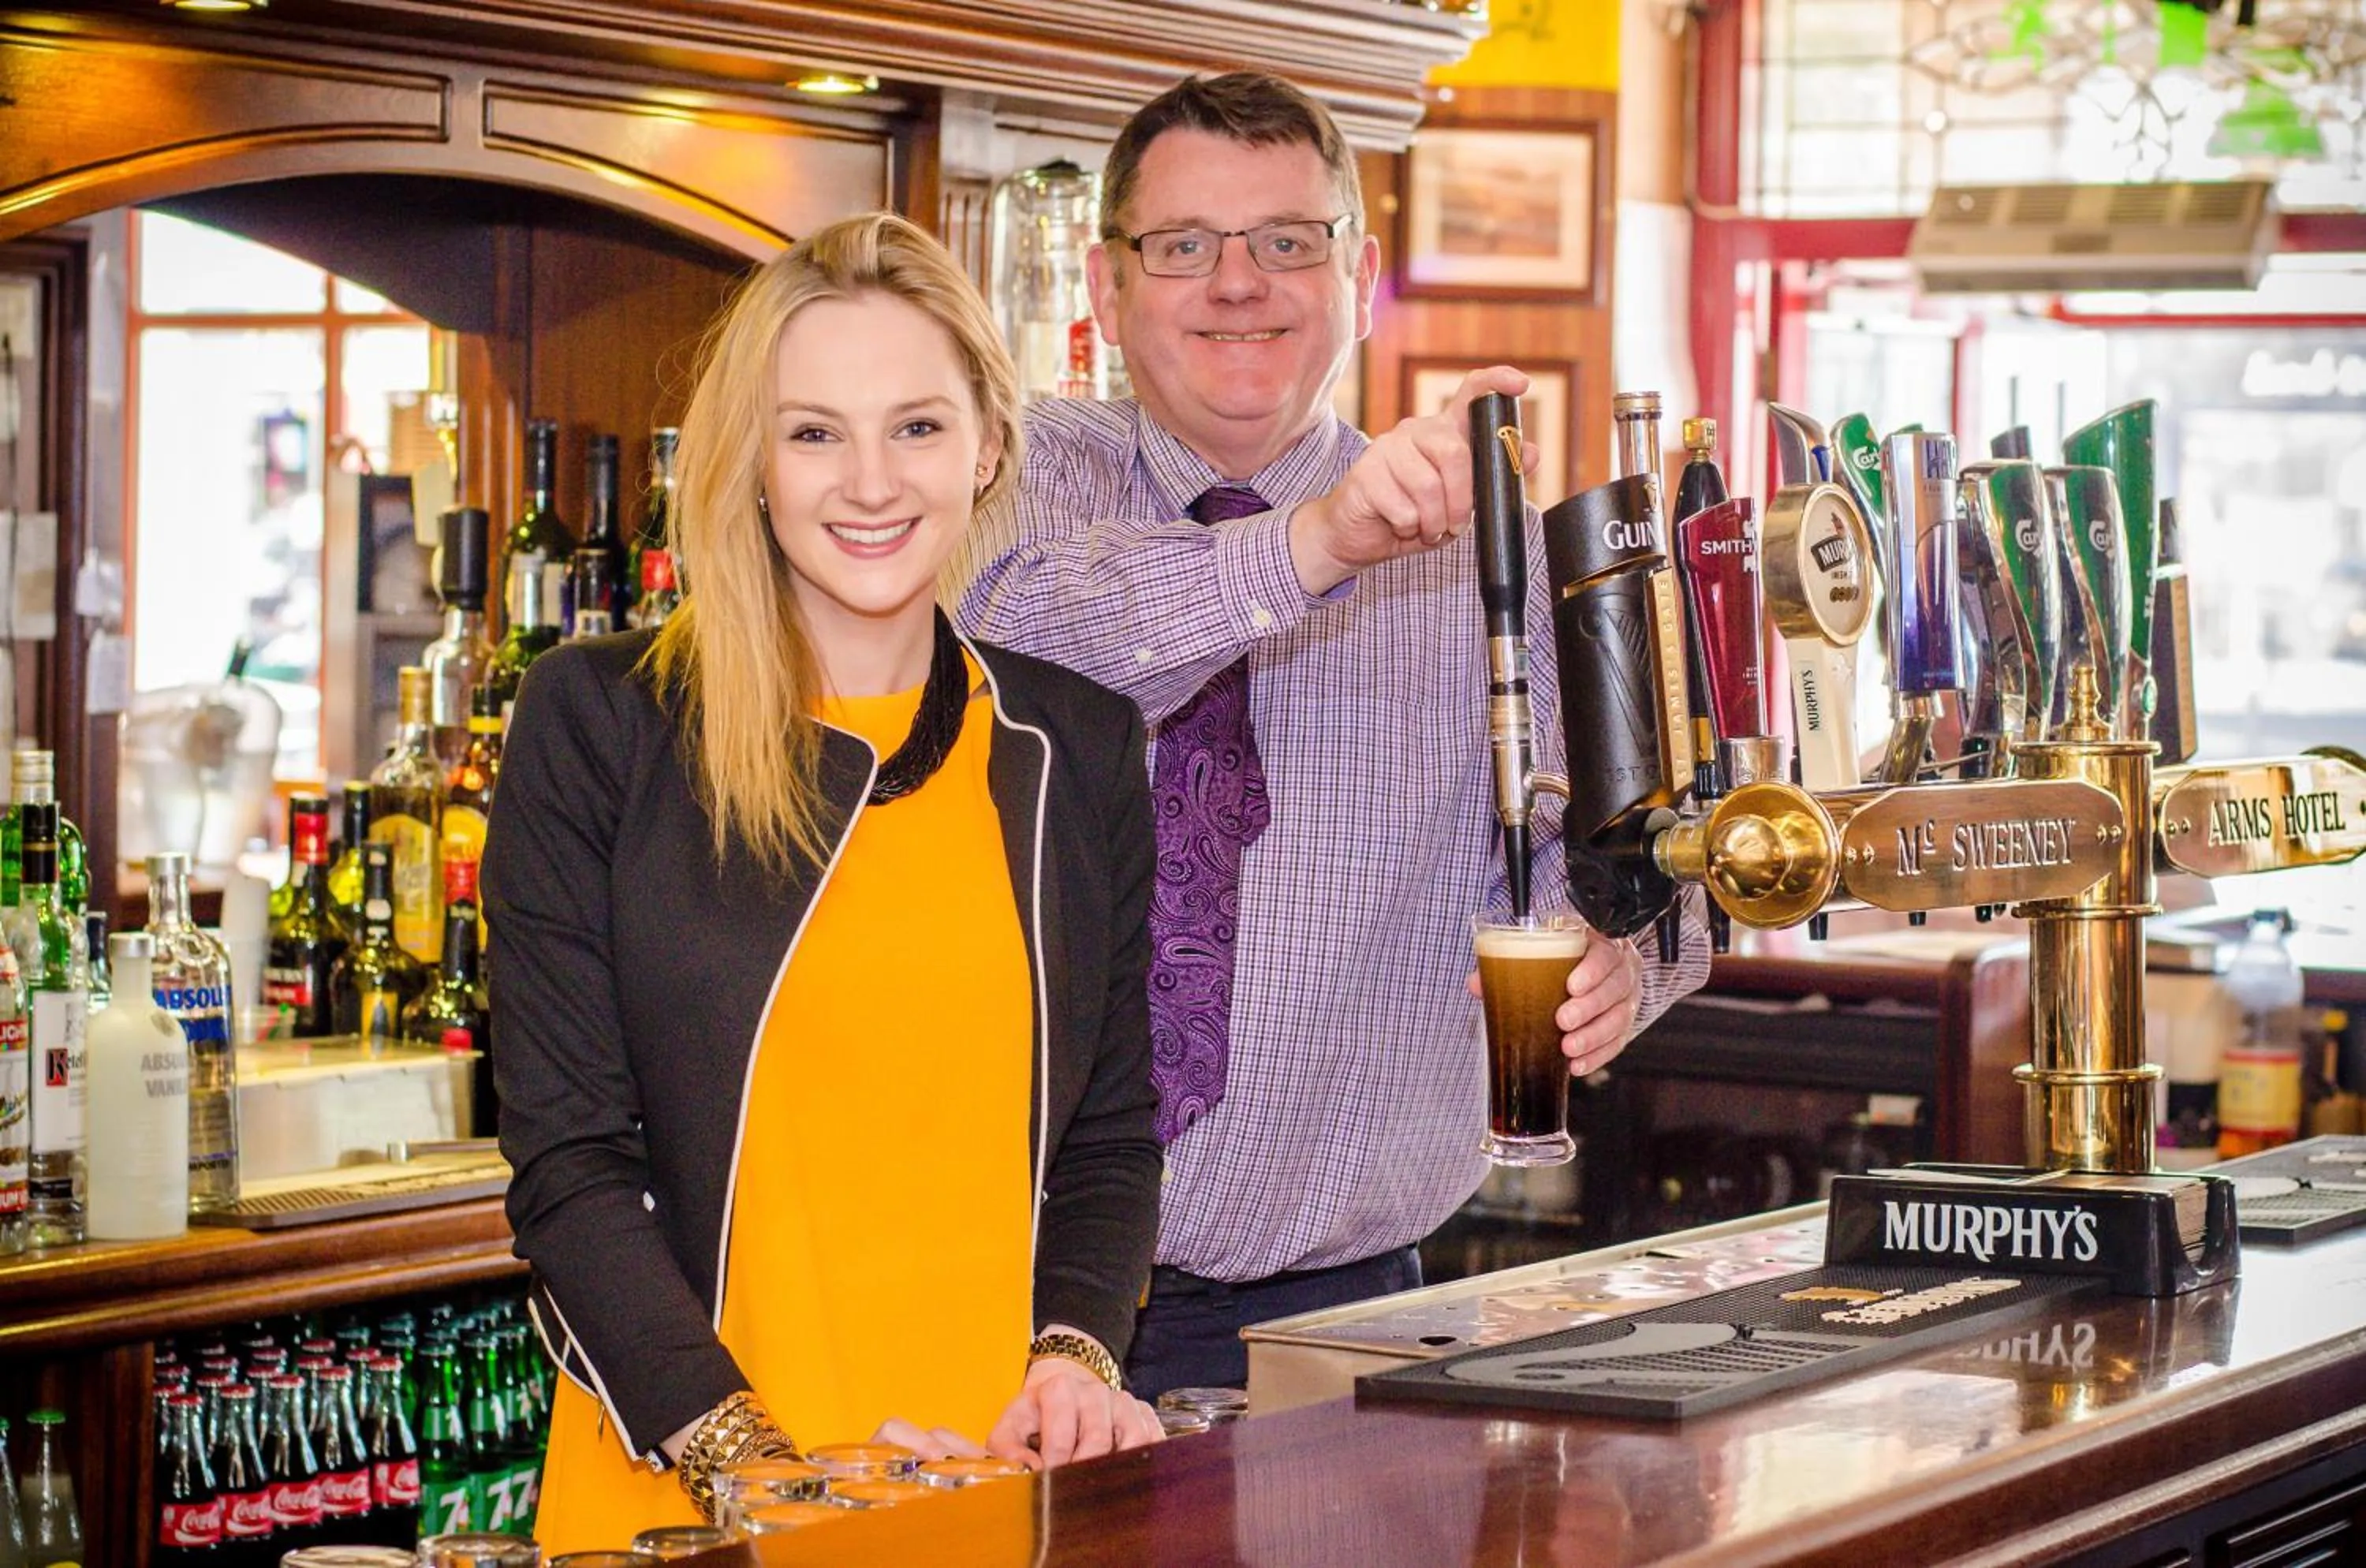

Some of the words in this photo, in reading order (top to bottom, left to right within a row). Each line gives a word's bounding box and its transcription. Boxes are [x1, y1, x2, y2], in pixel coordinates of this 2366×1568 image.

[1951, 818, 2077, 872] SWEENEY
[2208, 797, 2272, 847] ARMS
[2282, 791, 2346, 838] HOTEL
[1883, 1200, 2099, 1263] MURPHY'S
